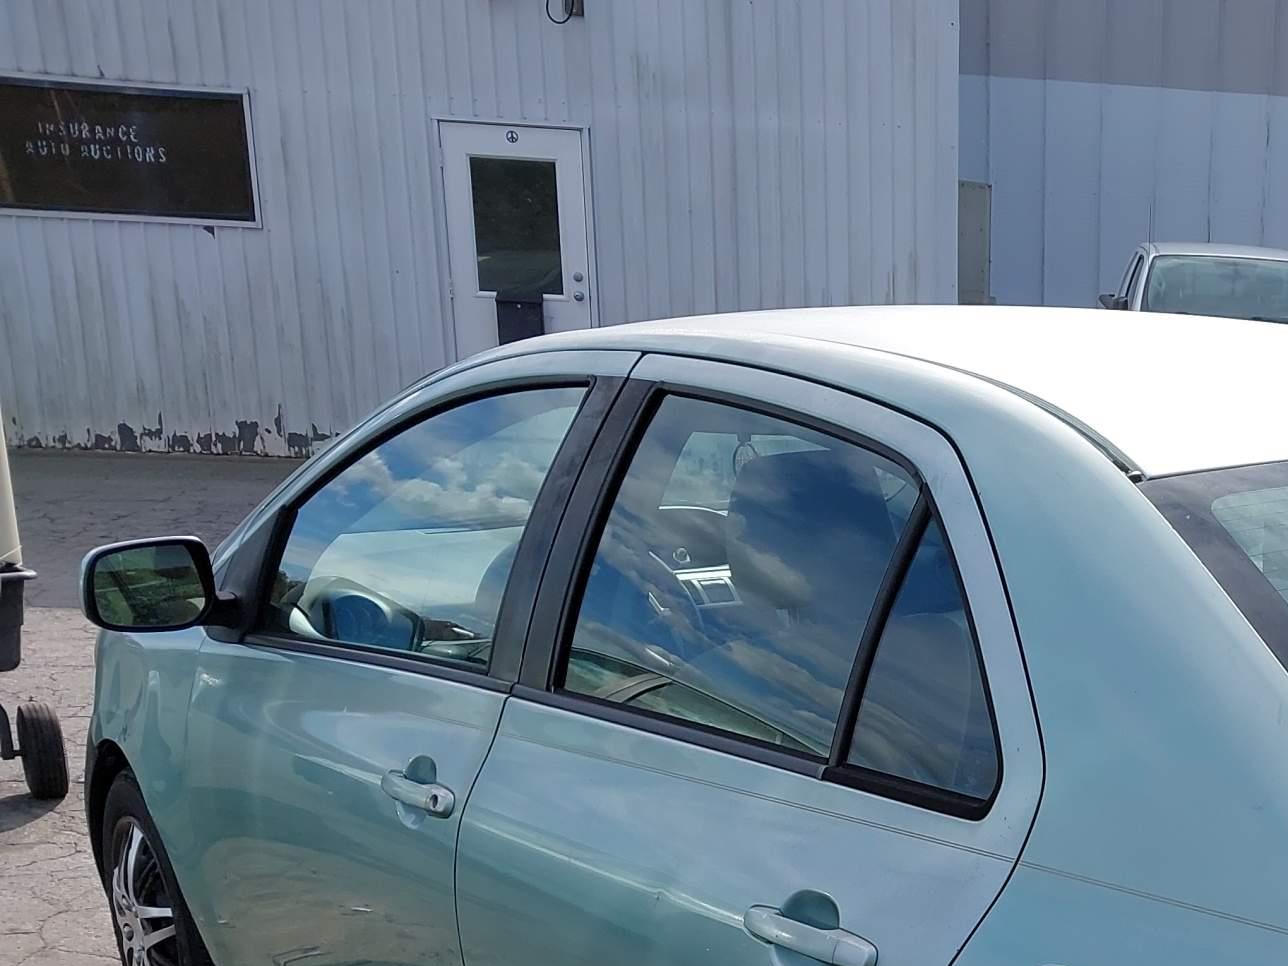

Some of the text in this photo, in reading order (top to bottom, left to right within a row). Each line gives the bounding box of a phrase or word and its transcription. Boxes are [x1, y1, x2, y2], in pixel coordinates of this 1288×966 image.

[38, 121, 139, 143] INSURANCE
[25, 140, 168, 163] AUTO AUCTIONS
